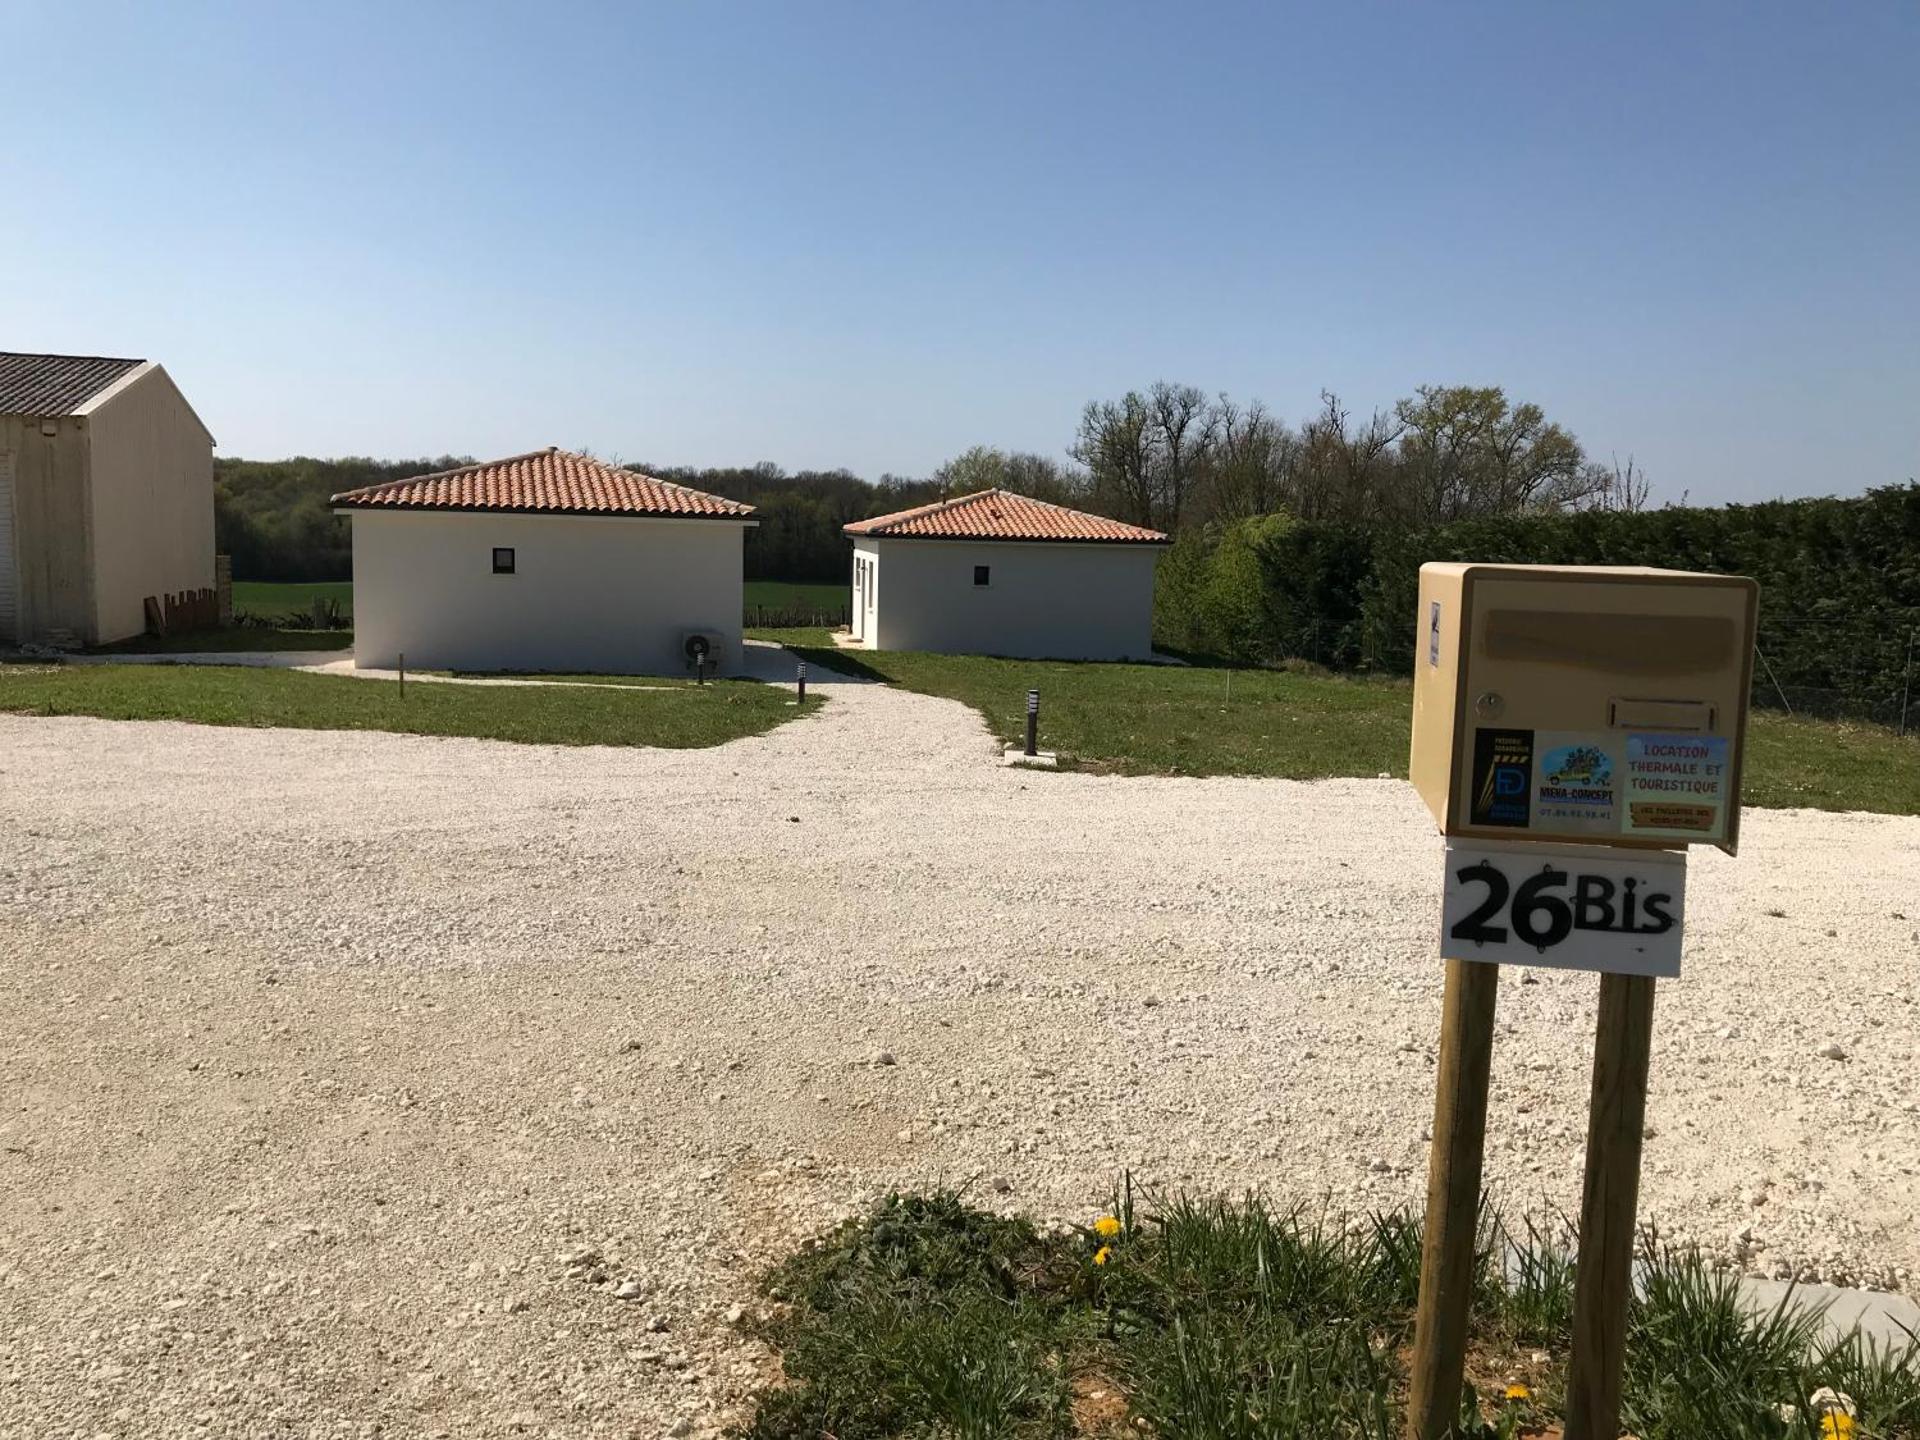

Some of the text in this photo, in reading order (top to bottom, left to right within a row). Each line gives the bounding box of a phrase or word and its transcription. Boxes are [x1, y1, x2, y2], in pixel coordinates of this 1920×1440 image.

[1643, 744, 1710, 759] LOCATION
[1628, 760, 1723, 776] THERMALE ET
[1631, 777, 1720, 794] TOURISTIQUE
